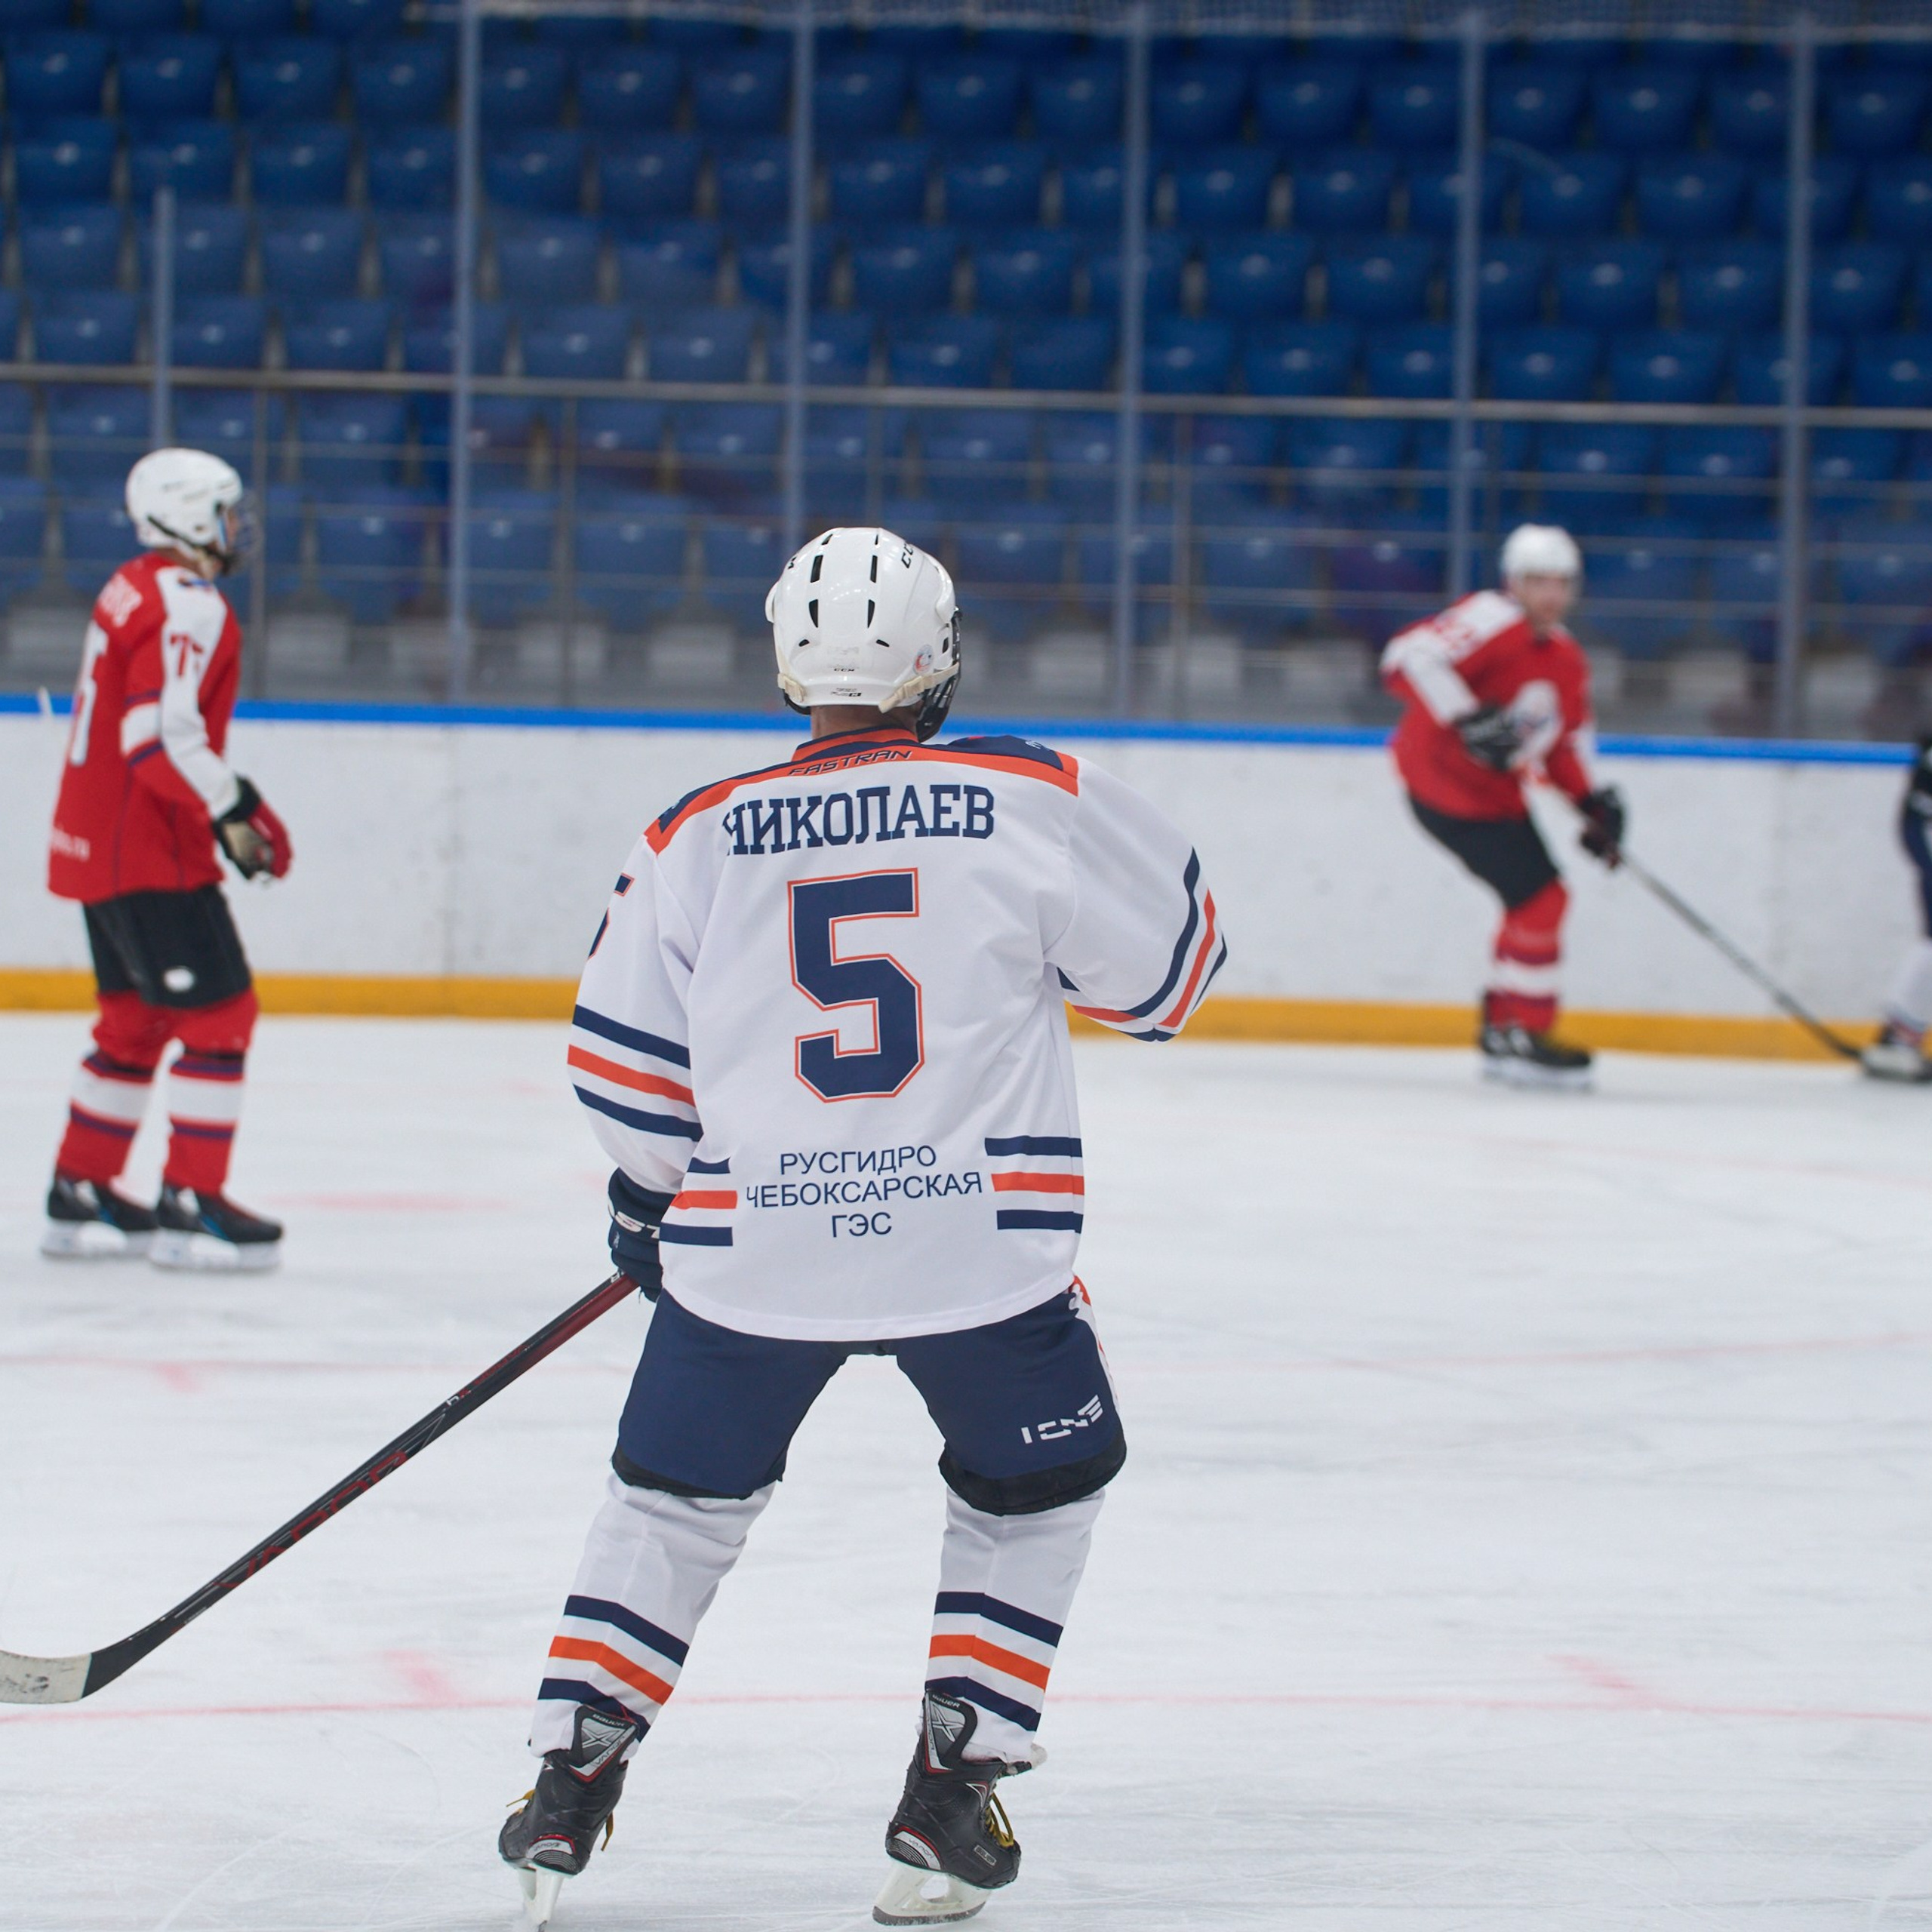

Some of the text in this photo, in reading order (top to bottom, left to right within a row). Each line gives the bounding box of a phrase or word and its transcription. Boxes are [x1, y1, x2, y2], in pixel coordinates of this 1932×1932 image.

[900, 543, 914, 569] CC
[789, 750, 912, 776] FASTRAN
[787, 867, 924, 1103] 5
[780, 1145, 937, 1175] РУСГИДРО
[746, 1172, 983, 1208] ЧЕБОКСАРСКАЯ
[831, 1212, 892, 1238] ГЭС
